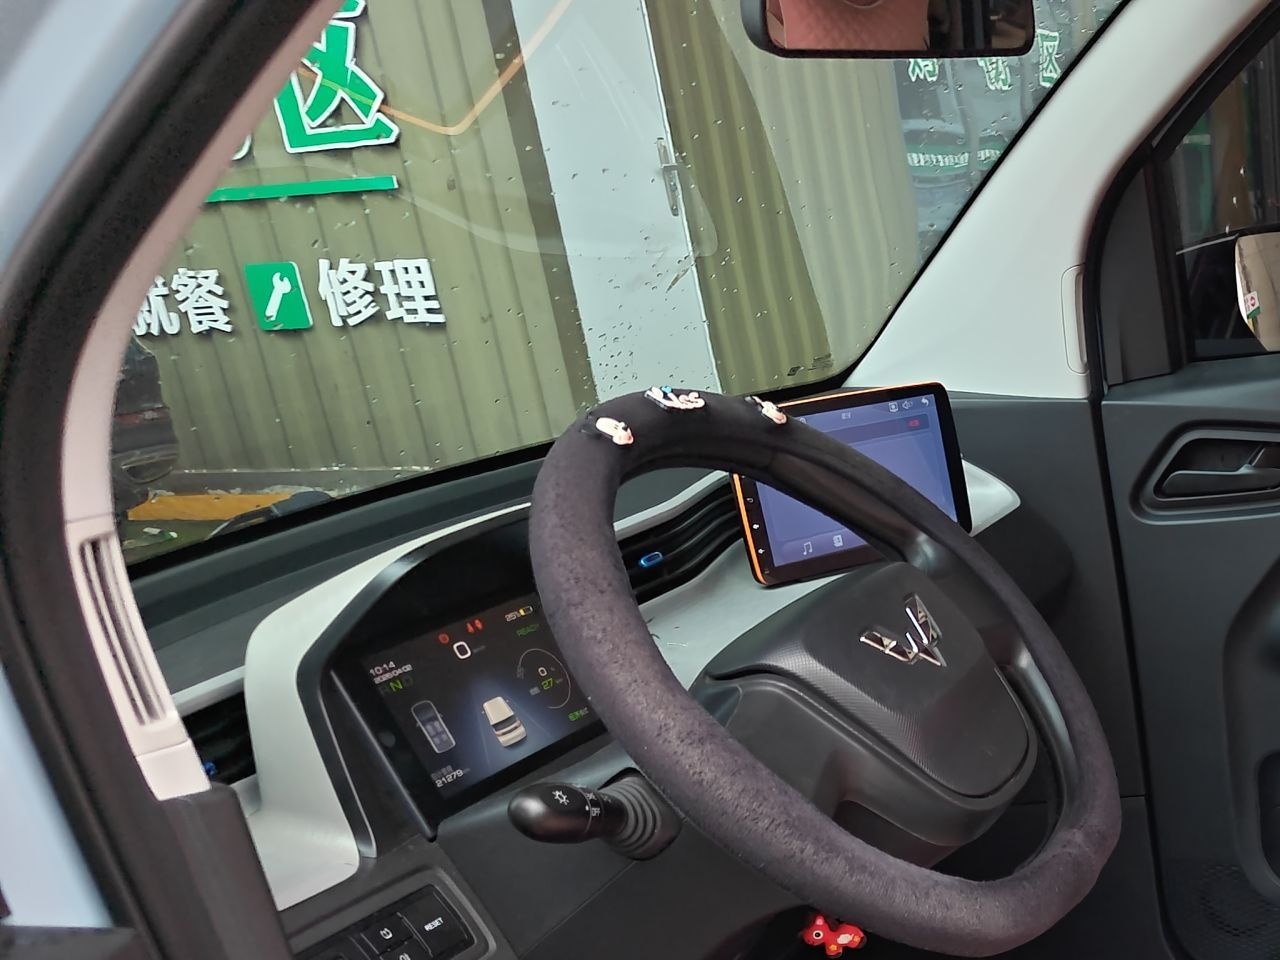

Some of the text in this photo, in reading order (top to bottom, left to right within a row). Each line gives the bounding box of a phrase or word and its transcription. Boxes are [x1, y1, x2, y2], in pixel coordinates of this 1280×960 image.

[318, 258, 446, 327] 修理
[453, 641, 472, 659] 0
[389, 679, 403, 692] N
[541, 678, 554, 690] 27
[435, 769, 464, 788] 21279
[424, 917, 444, 931] RESET
